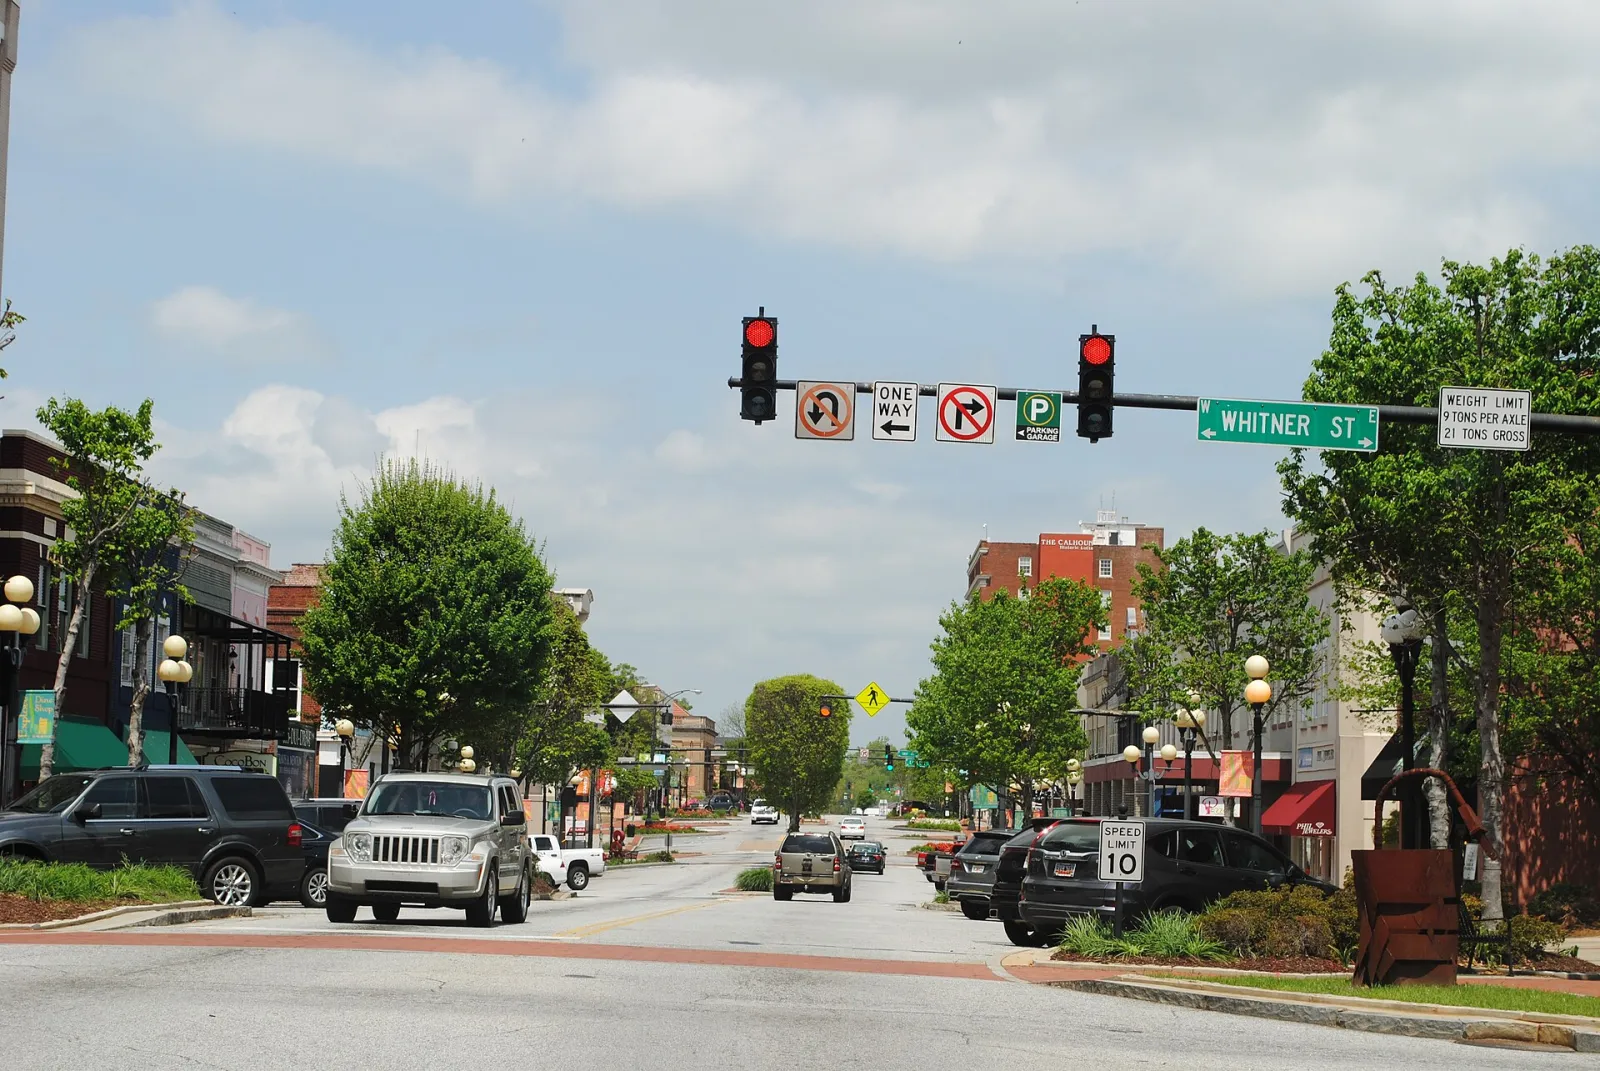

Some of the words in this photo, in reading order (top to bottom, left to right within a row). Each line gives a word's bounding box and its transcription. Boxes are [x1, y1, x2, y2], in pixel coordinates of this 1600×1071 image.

[880, 386, 913, 401] ONE
[1200, 399, 1211, 414] W
[1447, 394, 1487, 407] WEIGHT
[1495, 396, 1524, 409] LIMIT
[879, 402, 913, 417] WAY
[1030, 398, 1049, 421] P
[1368, 409, 1377, 423] E
[1221, 410, 1311, 436] WHITNER
[1329, 416, 1356, 439] ST
[1443, 411, 1450, 421] 9
[1452, 411, 1477, 423] TONS
[1480, 412, 1499, 424] PER
[1501, 413, 1527, 425] AXLE
[1026, 426, 1059, 435] PARKING
[1026, 433, 1058, 441] GARAGE
[1444, 427, 1455, 439] 21
[1462, 428, 1488, 440] TONS
[1493, 429, 1525, 442] GROSS
[1104, 827, 1141, 837] SPEED
[1107, 840, 1136, 849] LIMIT
[1107, 853, 1137, 874] 10
